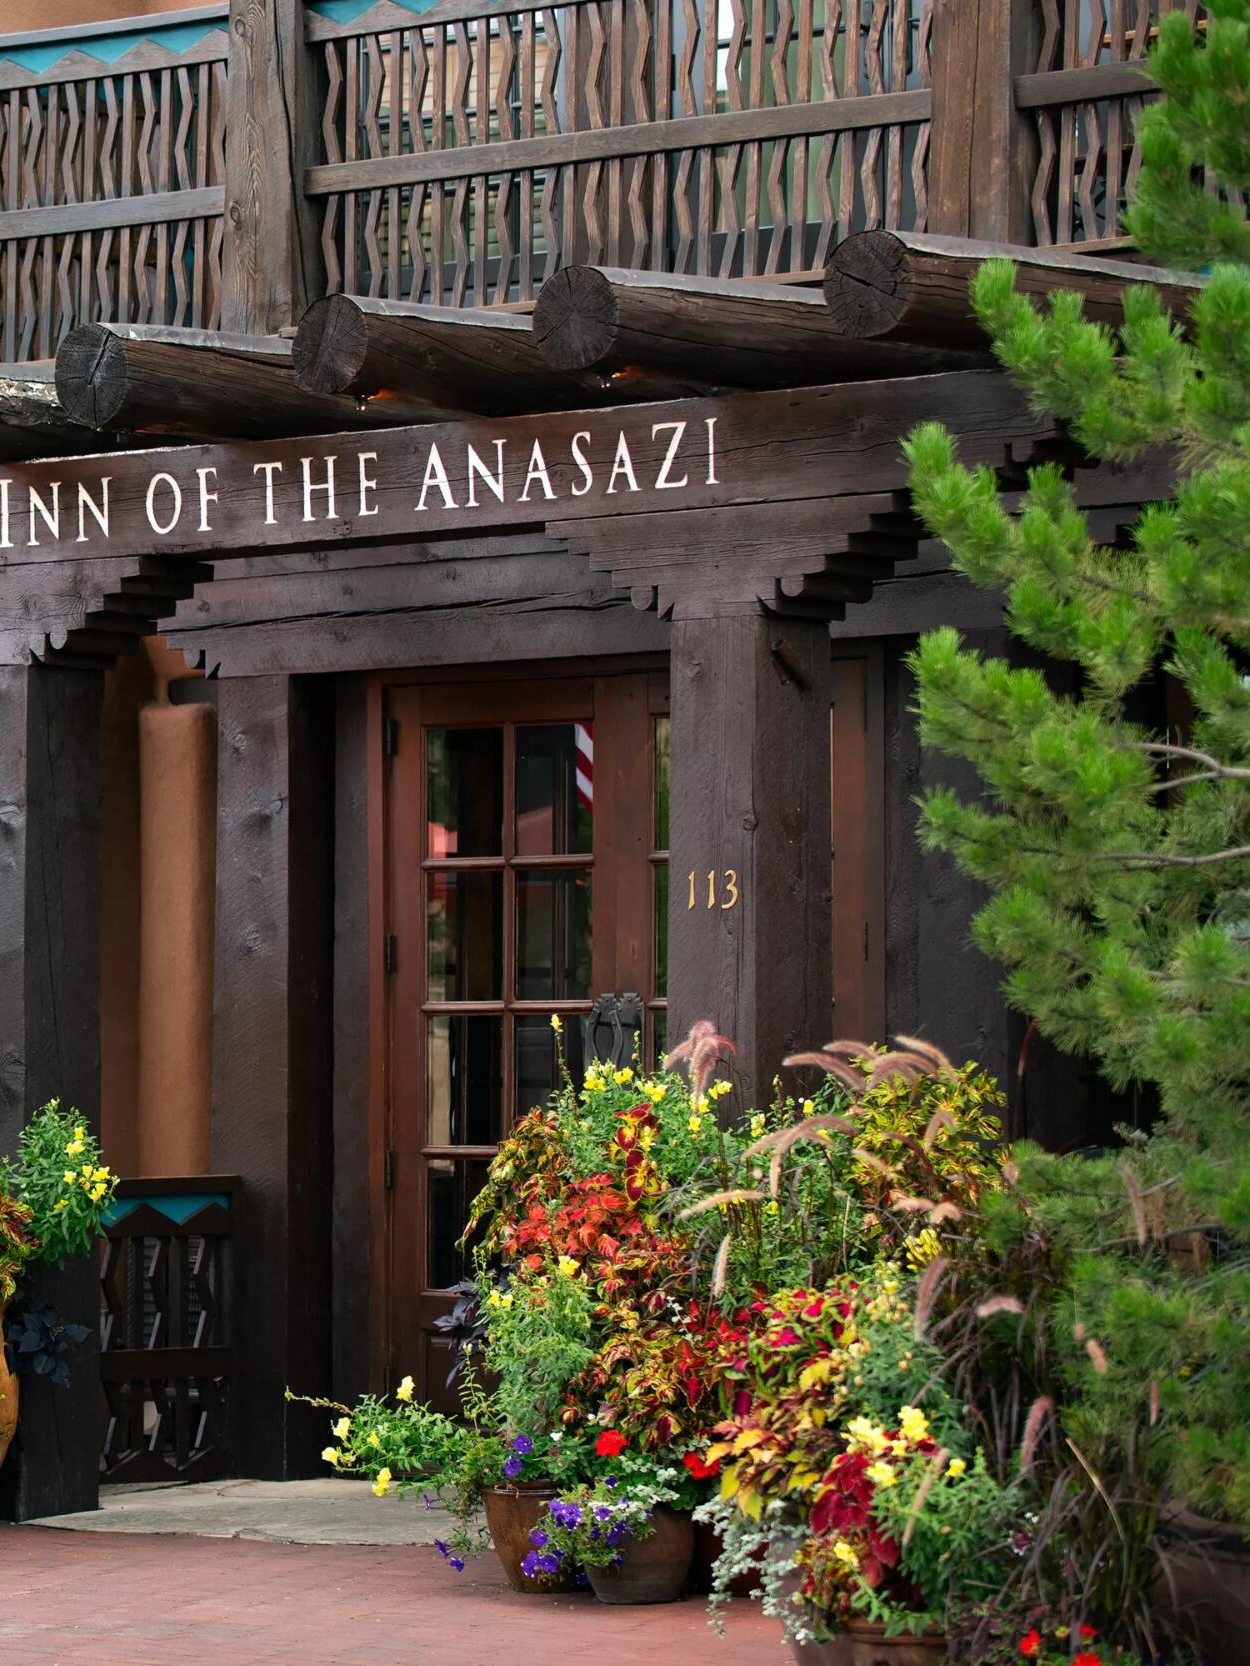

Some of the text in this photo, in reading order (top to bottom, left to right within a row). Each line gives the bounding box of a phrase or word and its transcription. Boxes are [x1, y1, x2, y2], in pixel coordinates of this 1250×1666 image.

[145, 467, 219, 535] OF
[253, 452, 379, 525] THE
[414, 417, 718, 512] ANASAZI
[687, 869, 739, 910] 113
